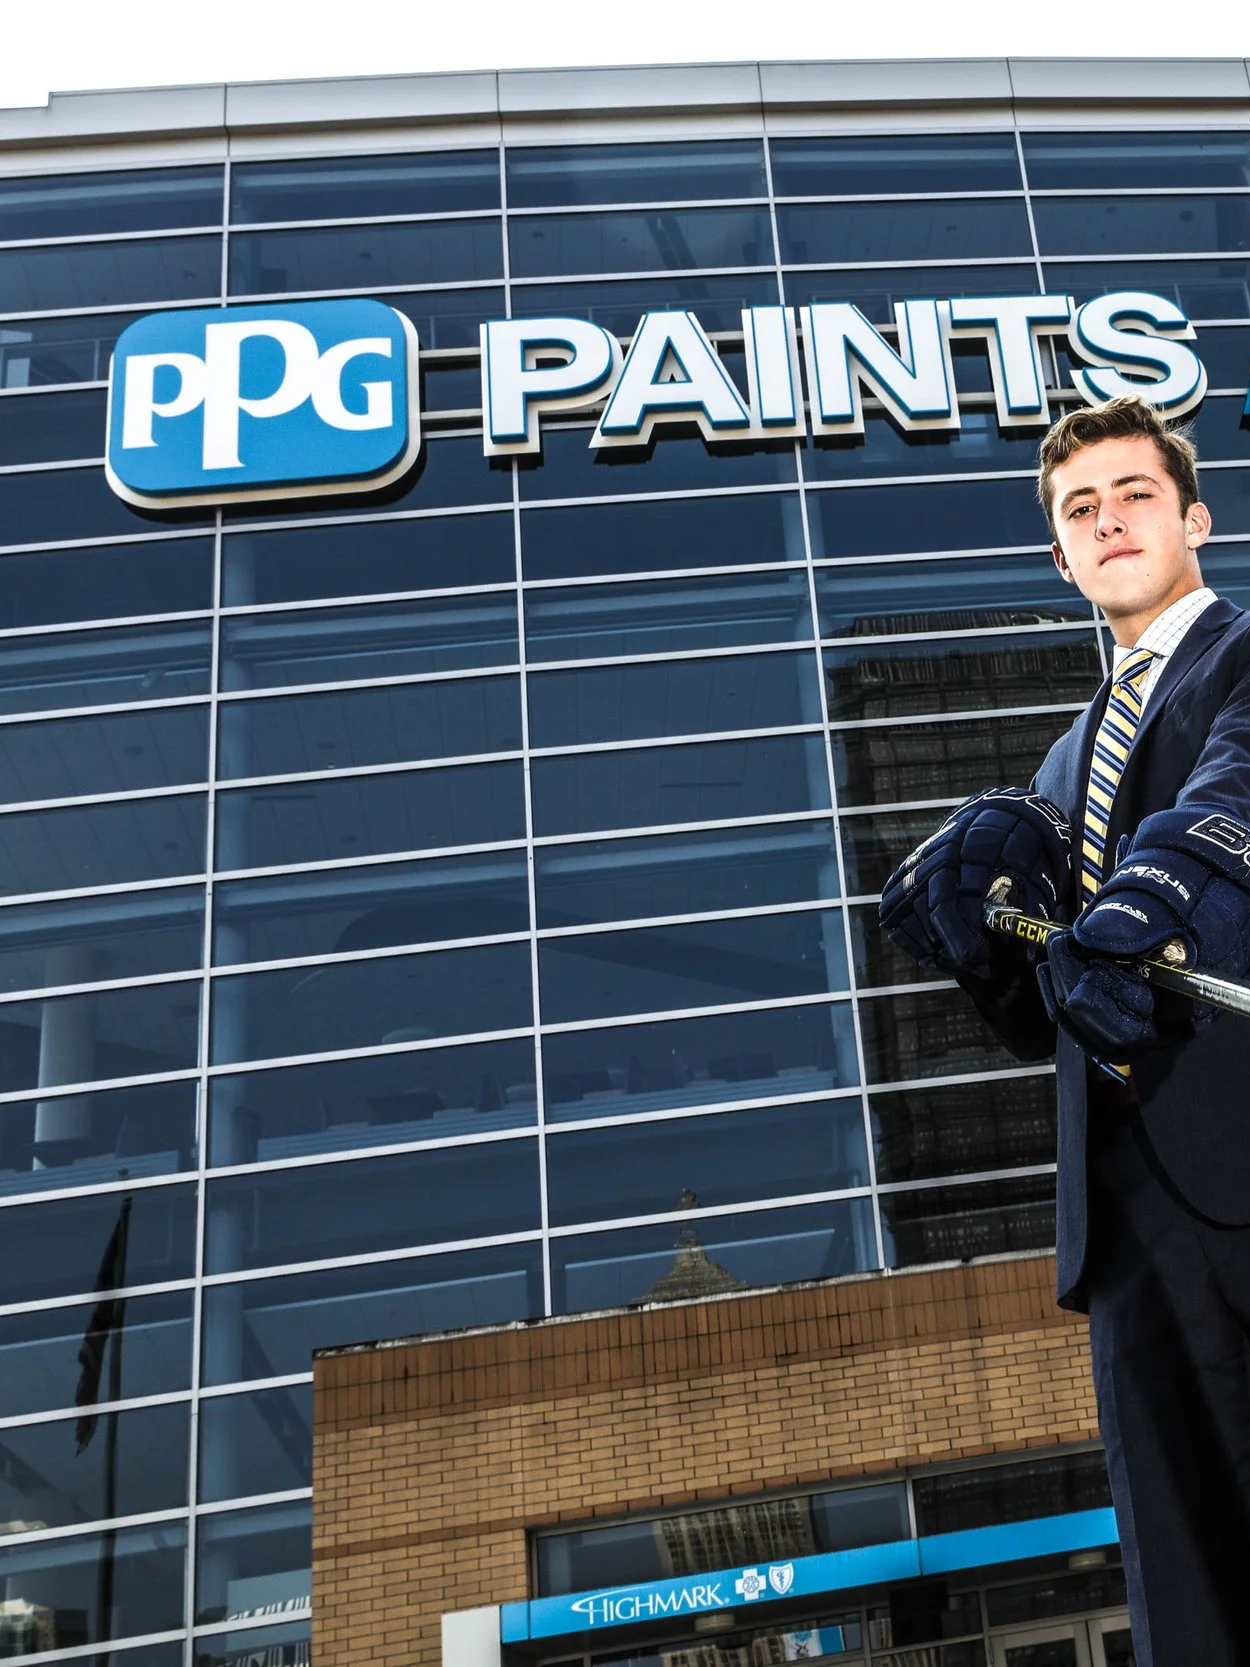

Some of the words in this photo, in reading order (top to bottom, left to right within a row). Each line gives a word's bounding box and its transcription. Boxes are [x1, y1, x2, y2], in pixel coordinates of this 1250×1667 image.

[122, 319, 393, 471] PPG
[485, 291, 1203, 445] PAINTS
[1114, 865, 1191, 901] NEXUS
[1016, 920, 1049, 945] CCM
[571, 1583, 724, 1625] HIGHMARK
